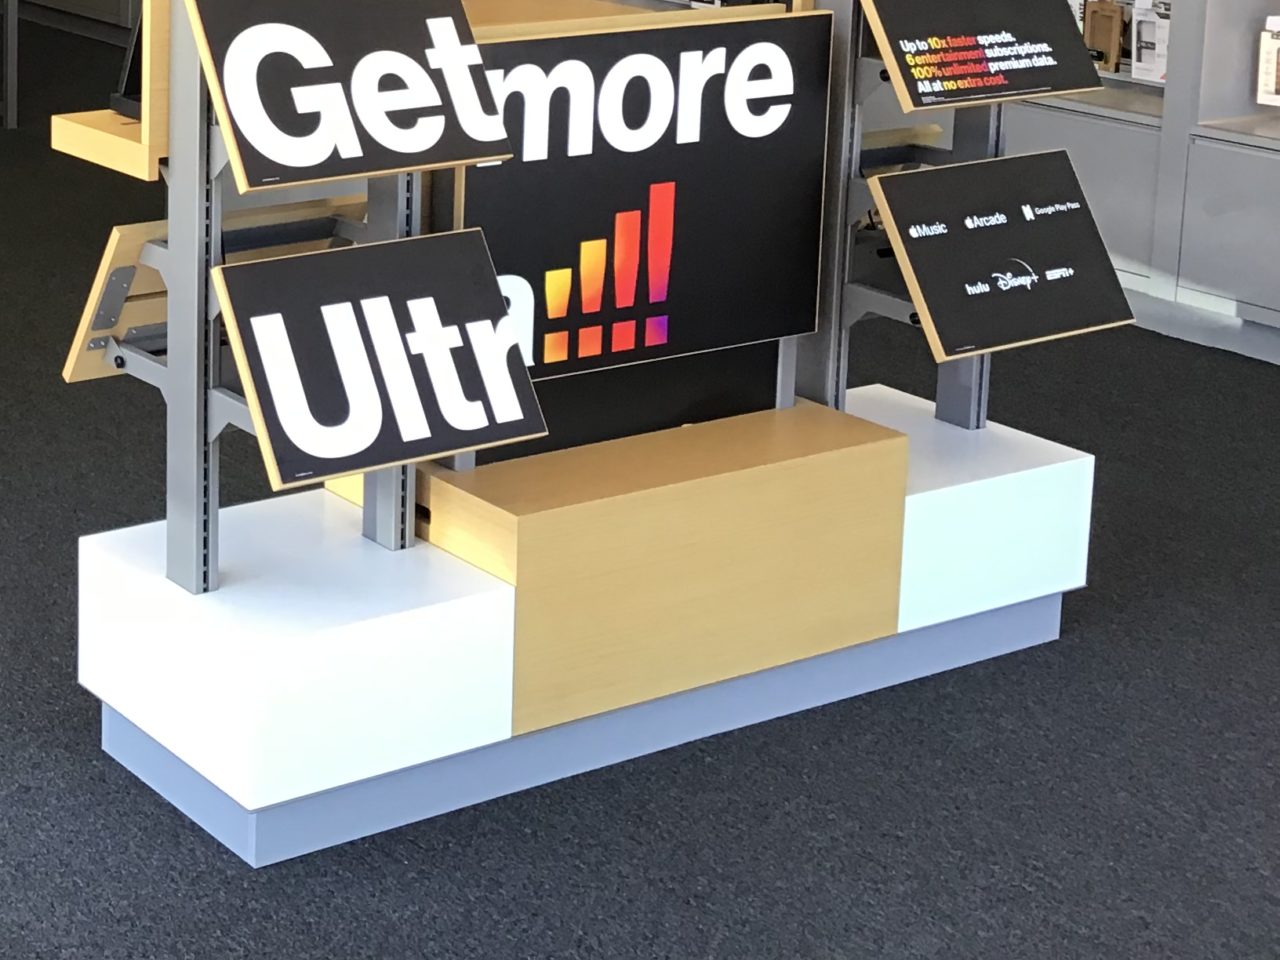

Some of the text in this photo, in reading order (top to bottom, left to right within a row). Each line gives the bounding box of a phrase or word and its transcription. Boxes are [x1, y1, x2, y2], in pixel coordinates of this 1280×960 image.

[899, 31, 1016, 53] Up to 10x faster speeds.
[905, 42, 1053, 65] 6 entertainment subscriptions.
[911, 55, 1058, 79] 100% unlimited premium data.
[223, 17, 795, 168] Get more
[917, 73, 1008, 93] All at no extra cost.
[1035, 202, 1080, 215] Google Play Pass
[916, 222, 948, 237] Music
[973, 212, 1008, 228] Arcade
[965, 282, 990, 295] hulu
[992, 269, 1039, 290] Disney+
